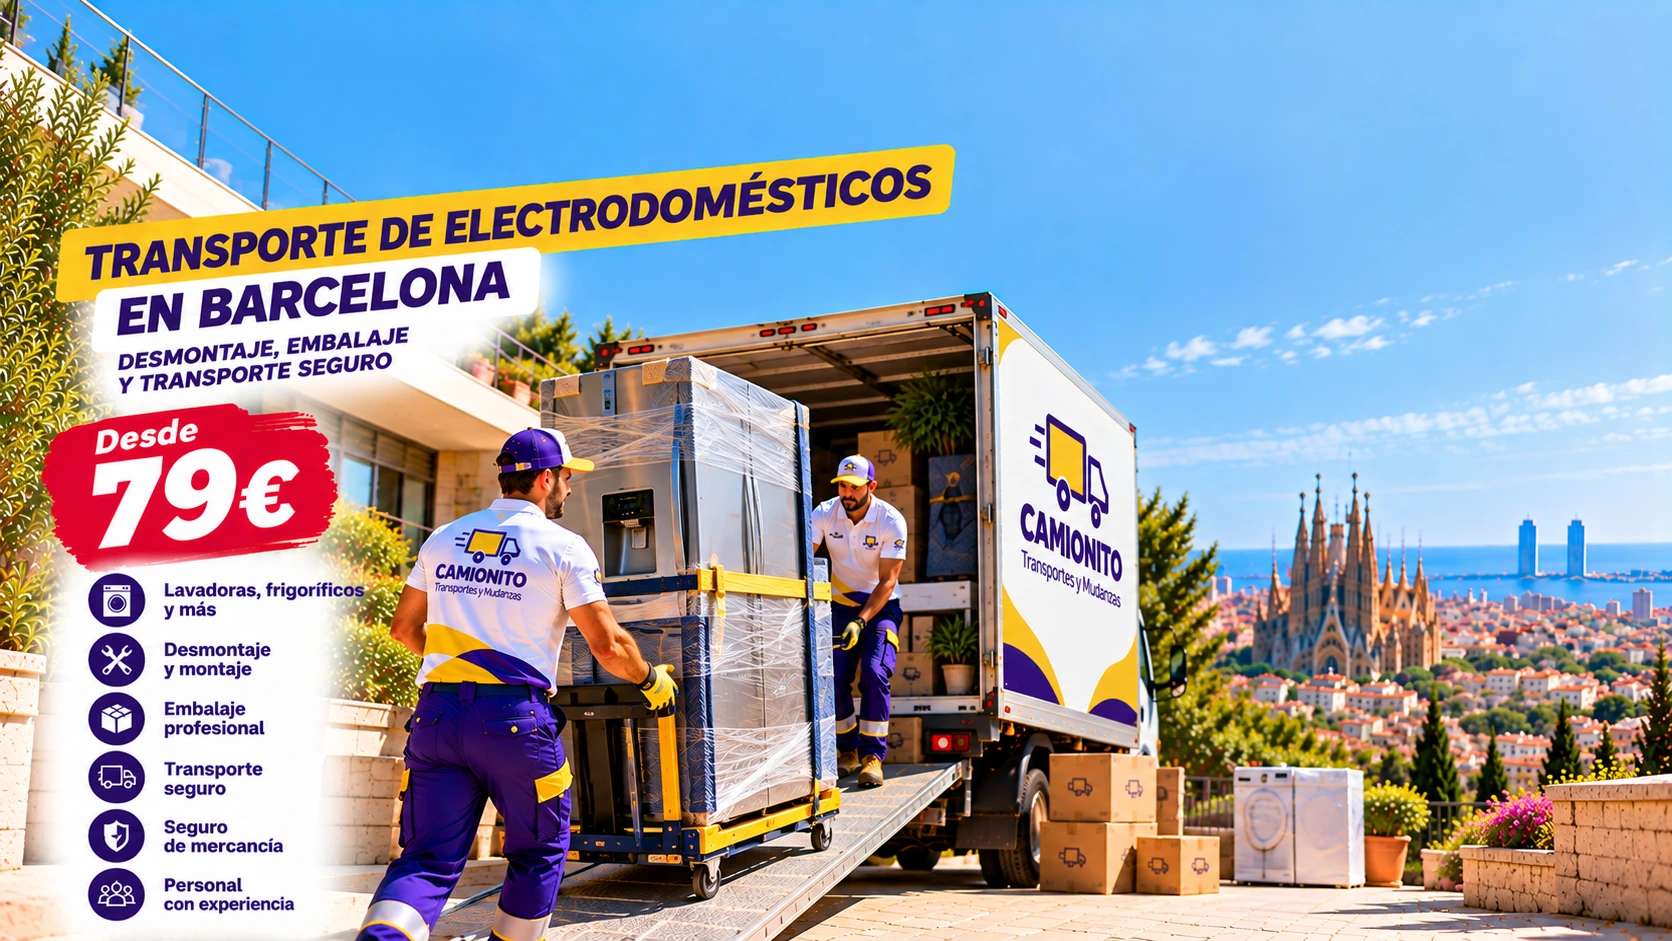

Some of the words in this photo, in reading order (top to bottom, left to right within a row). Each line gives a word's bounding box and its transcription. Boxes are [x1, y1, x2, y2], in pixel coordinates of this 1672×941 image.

[1020, 503, 1123, 582] CAMIONITO
[435, 563, 527, 588] CAMIONITO
[435, 583, 477, 595] Transportes
[478, 588, 484, 597] y
[484, 588, 521, 600] Mudanzas
[1021, 549, 1074, 588] Transportes
[1075, 577, 1082, 594] y
[1082, 577, 1121, 608] Mudanzas
